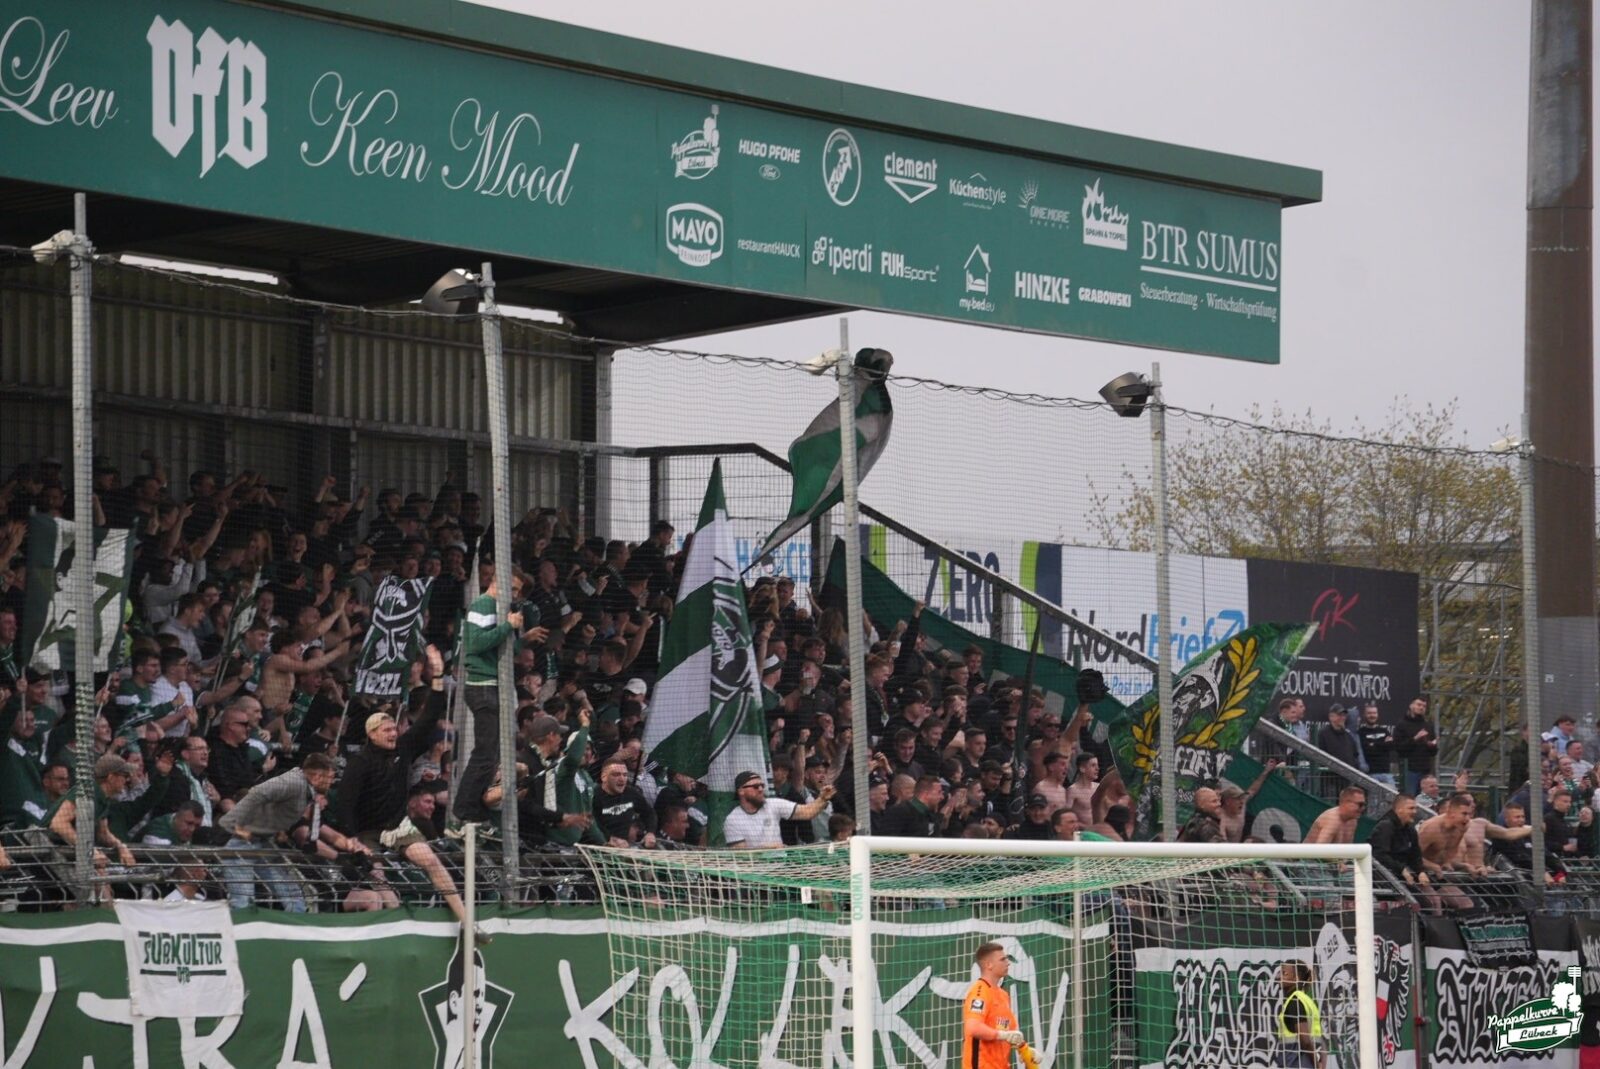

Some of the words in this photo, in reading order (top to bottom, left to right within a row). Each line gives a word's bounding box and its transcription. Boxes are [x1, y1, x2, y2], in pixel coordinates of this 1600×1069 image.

[0, 16, 119, 129] Leev
[300, 71, 431, 183] Keen
[441, 98, 580, 206] Mood
[739, 139, 767, 158] HUGO
[768, 144, 800, 163] PFOHE
[884, 151, 938, 182] clement
[672, 215, 718, 246] MAYO
[828, 237, 872, 275] iperdi
[1141, 220, 1190, 267] BTR
[1196, 230, 1278, 281] SUMUS
[1014, 270, 1070, 305] HINZKE
[1078, 286, 1132, 308] GRABOWSKI
[1281, 669, 1338, 697] GOURMET
[1341, 672, 1391, 701] KONTOR
[143, 932, 223, 966] SUBKULTUR
